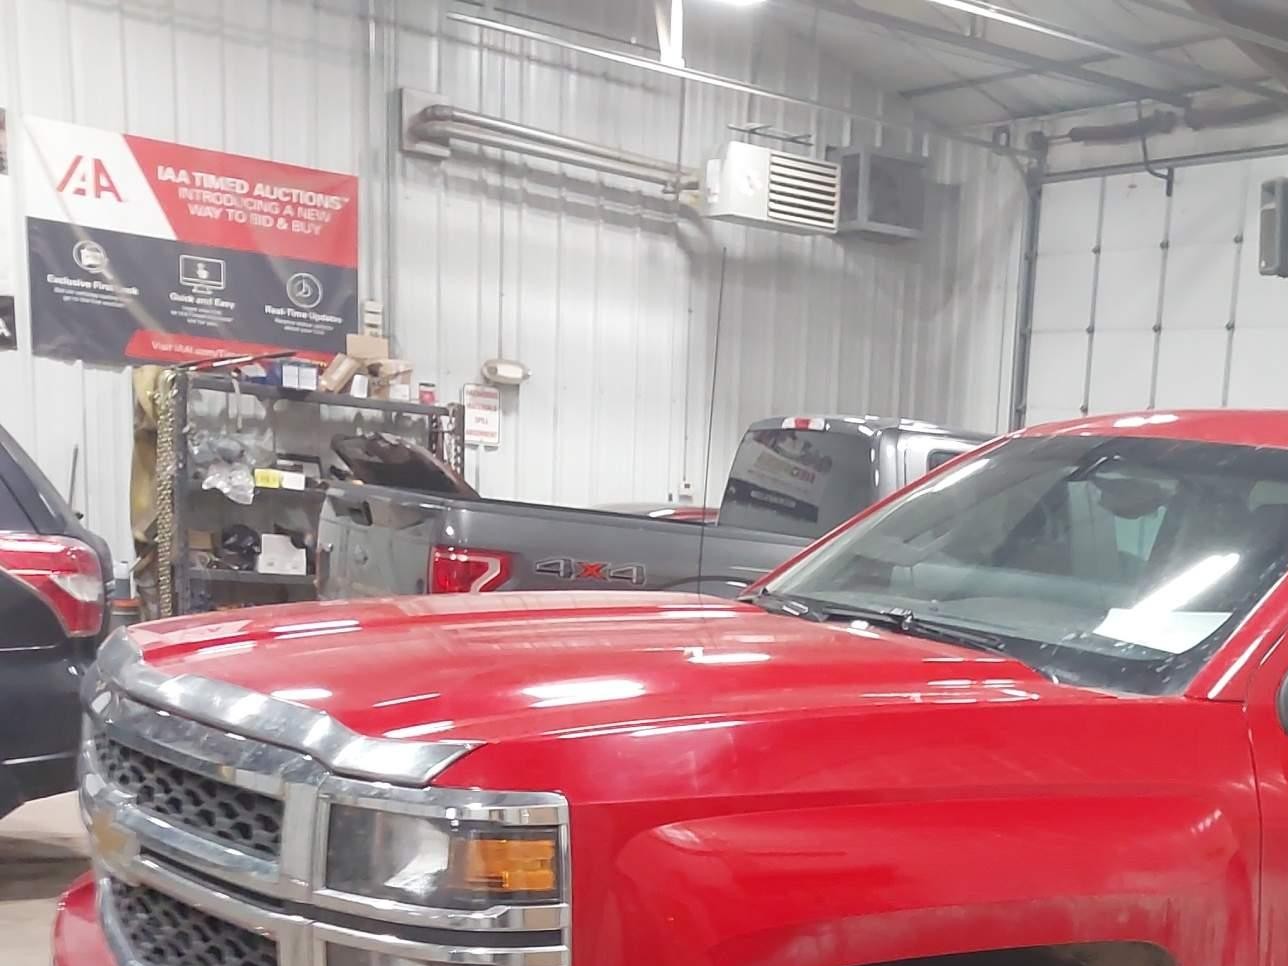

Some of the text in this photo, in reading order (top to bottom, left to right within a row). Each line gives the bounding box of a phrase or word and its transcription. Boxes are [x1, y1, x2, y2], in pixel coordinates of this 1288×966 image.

[157, 165, 190, 185] IAA
[192, 172, 249, 195] TIMED
[178, 187, 332, 223] INTRODUCING A NEW
[187, 203, 322, 235] WAY TO BID & BUY
